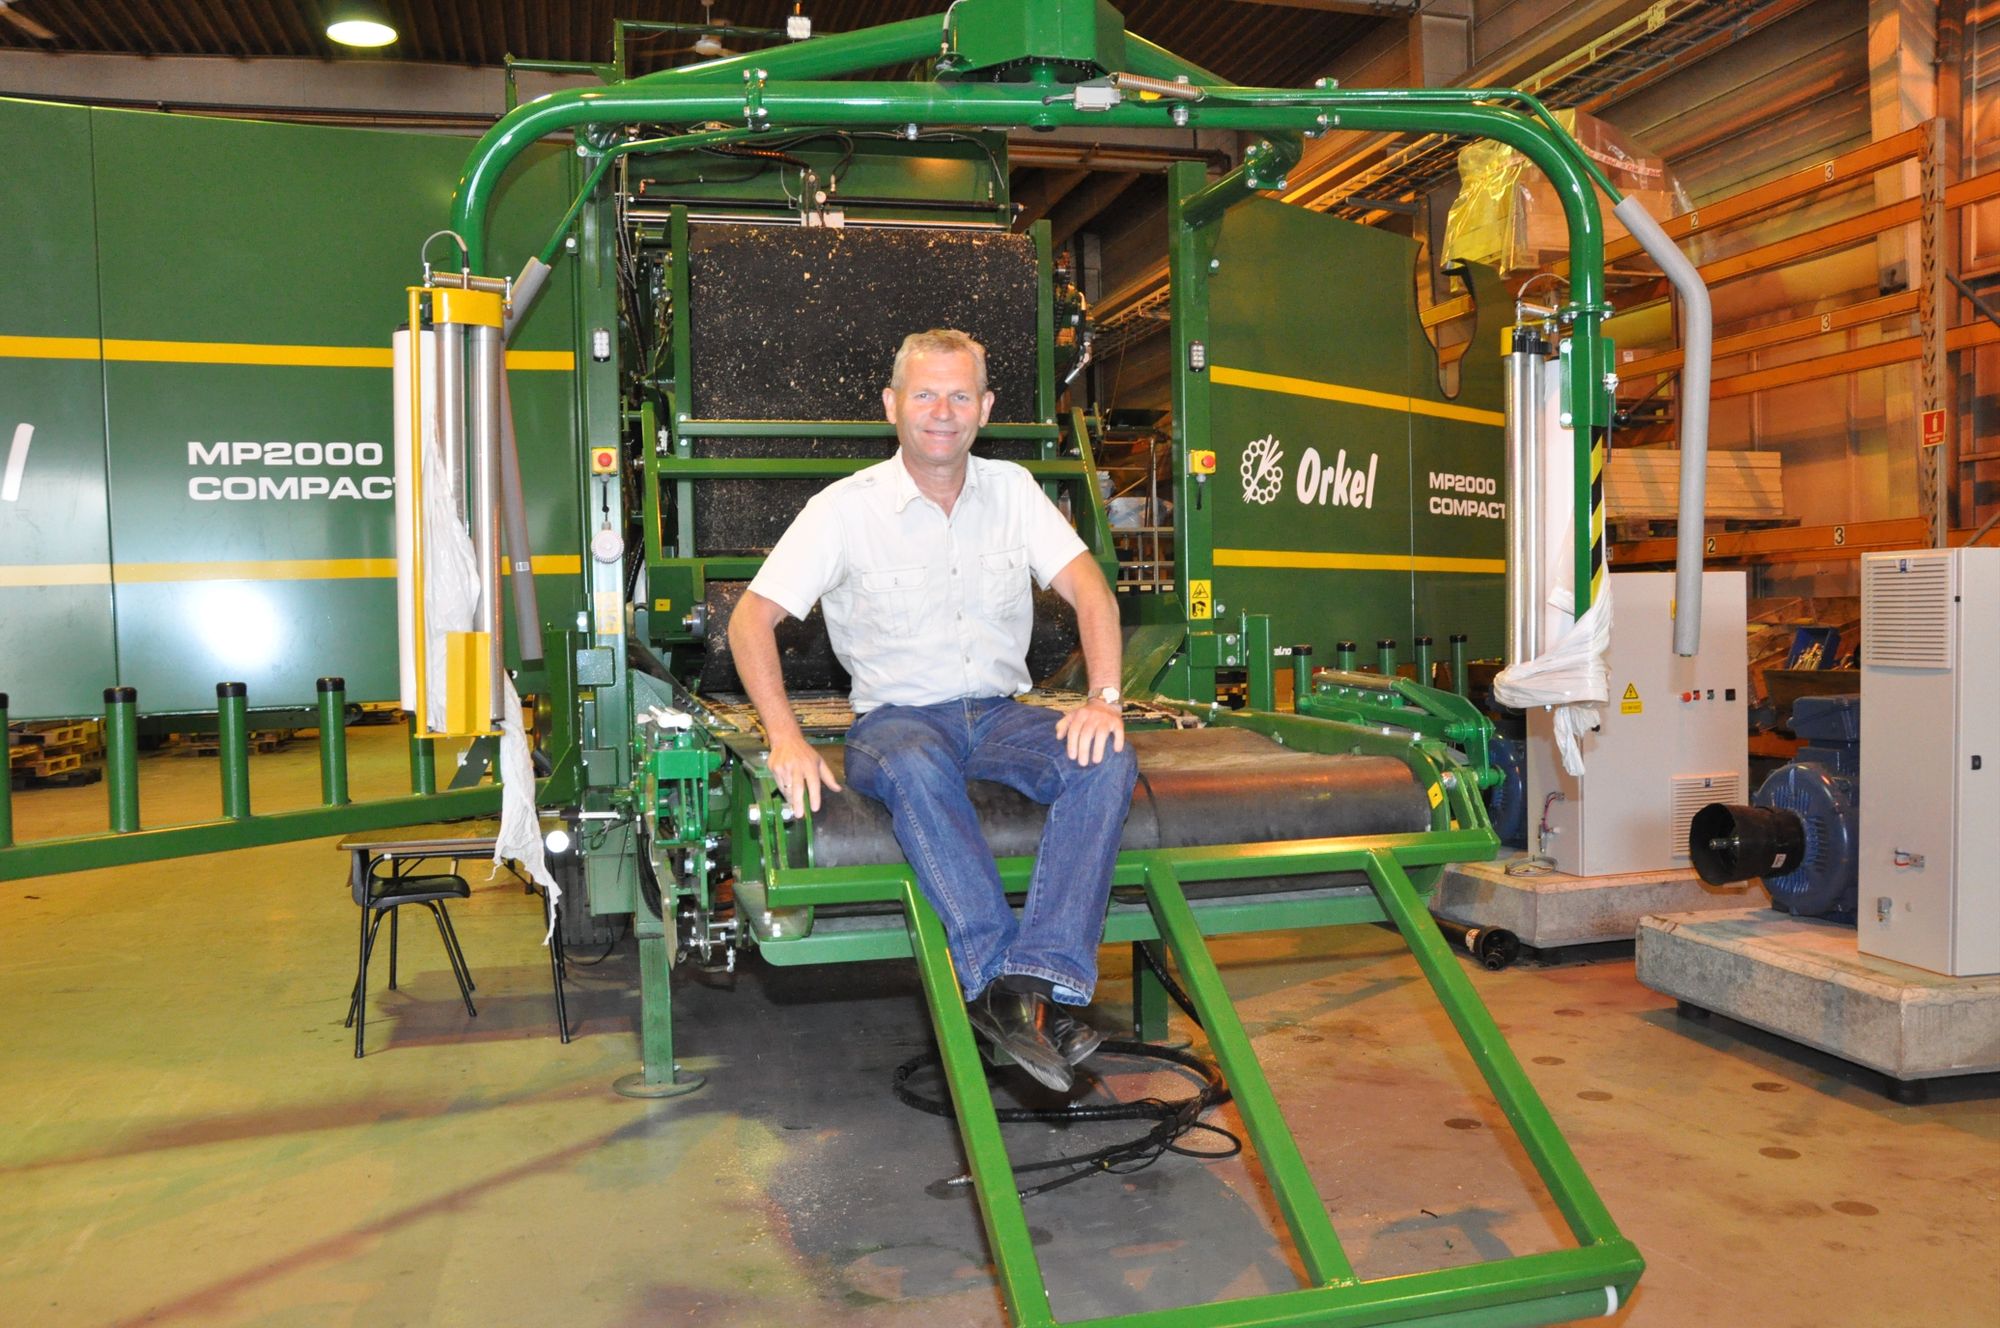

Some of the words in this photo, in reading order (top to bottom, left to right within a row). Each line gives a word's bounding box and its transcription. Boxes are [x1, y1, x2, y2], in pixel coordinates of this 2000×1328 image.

[1825, 164, 1834, 180] 3
[1691, 213, 1699, 228] 2
[1822, 314, 1831, 329] 3
[187, 441, 384, 466] MP2000
[1296, 447, 1379, 509] Orkel
[1429, 471, 1496, 496] MP2000
[188, 475, 396, 501] COMPAC
[1834, 527, 1845, 545] 3
[1707, 538, 1716, 553] 2
